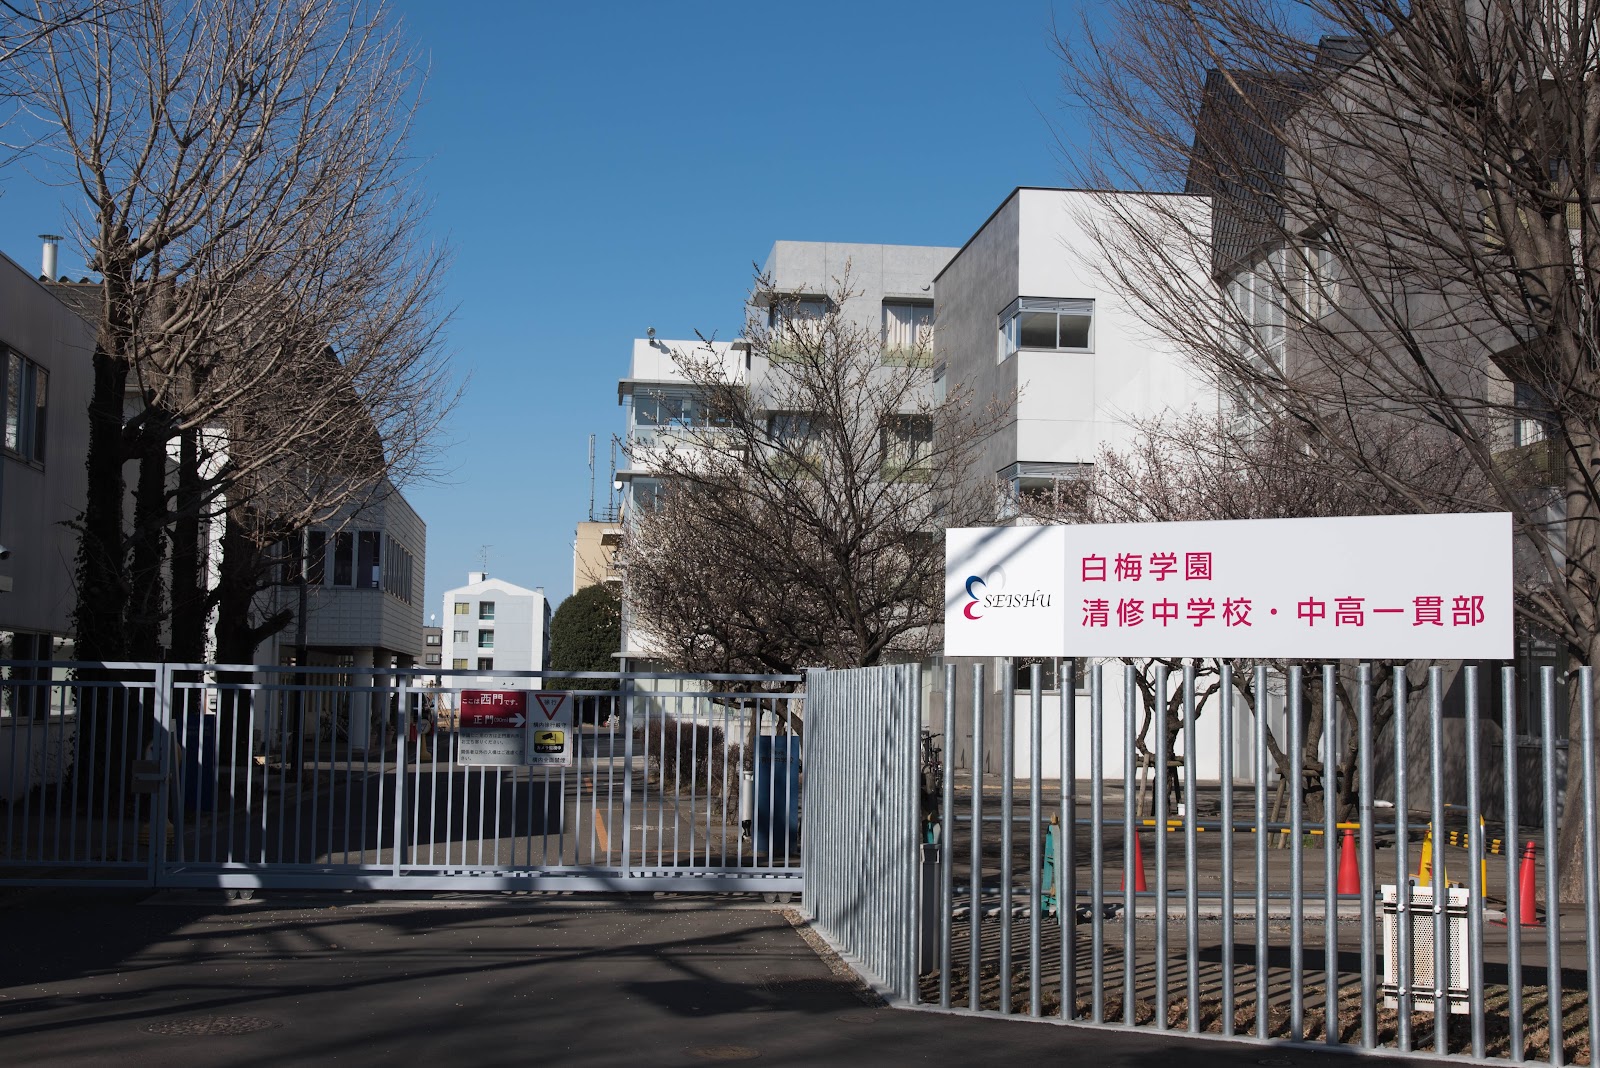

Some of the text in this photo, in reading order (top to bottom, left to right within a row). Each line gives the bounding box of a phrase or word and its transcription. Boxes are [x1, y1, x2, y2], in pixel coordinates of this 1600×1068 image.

[1081, 552, 1213, 582] 白梅学園
[983, 590, 1051, 609] SEISHU
[1081, 595, 1485, 627] 清修中学校・中高一貫部
[462, 694, 518, 706] ここは西門です。
